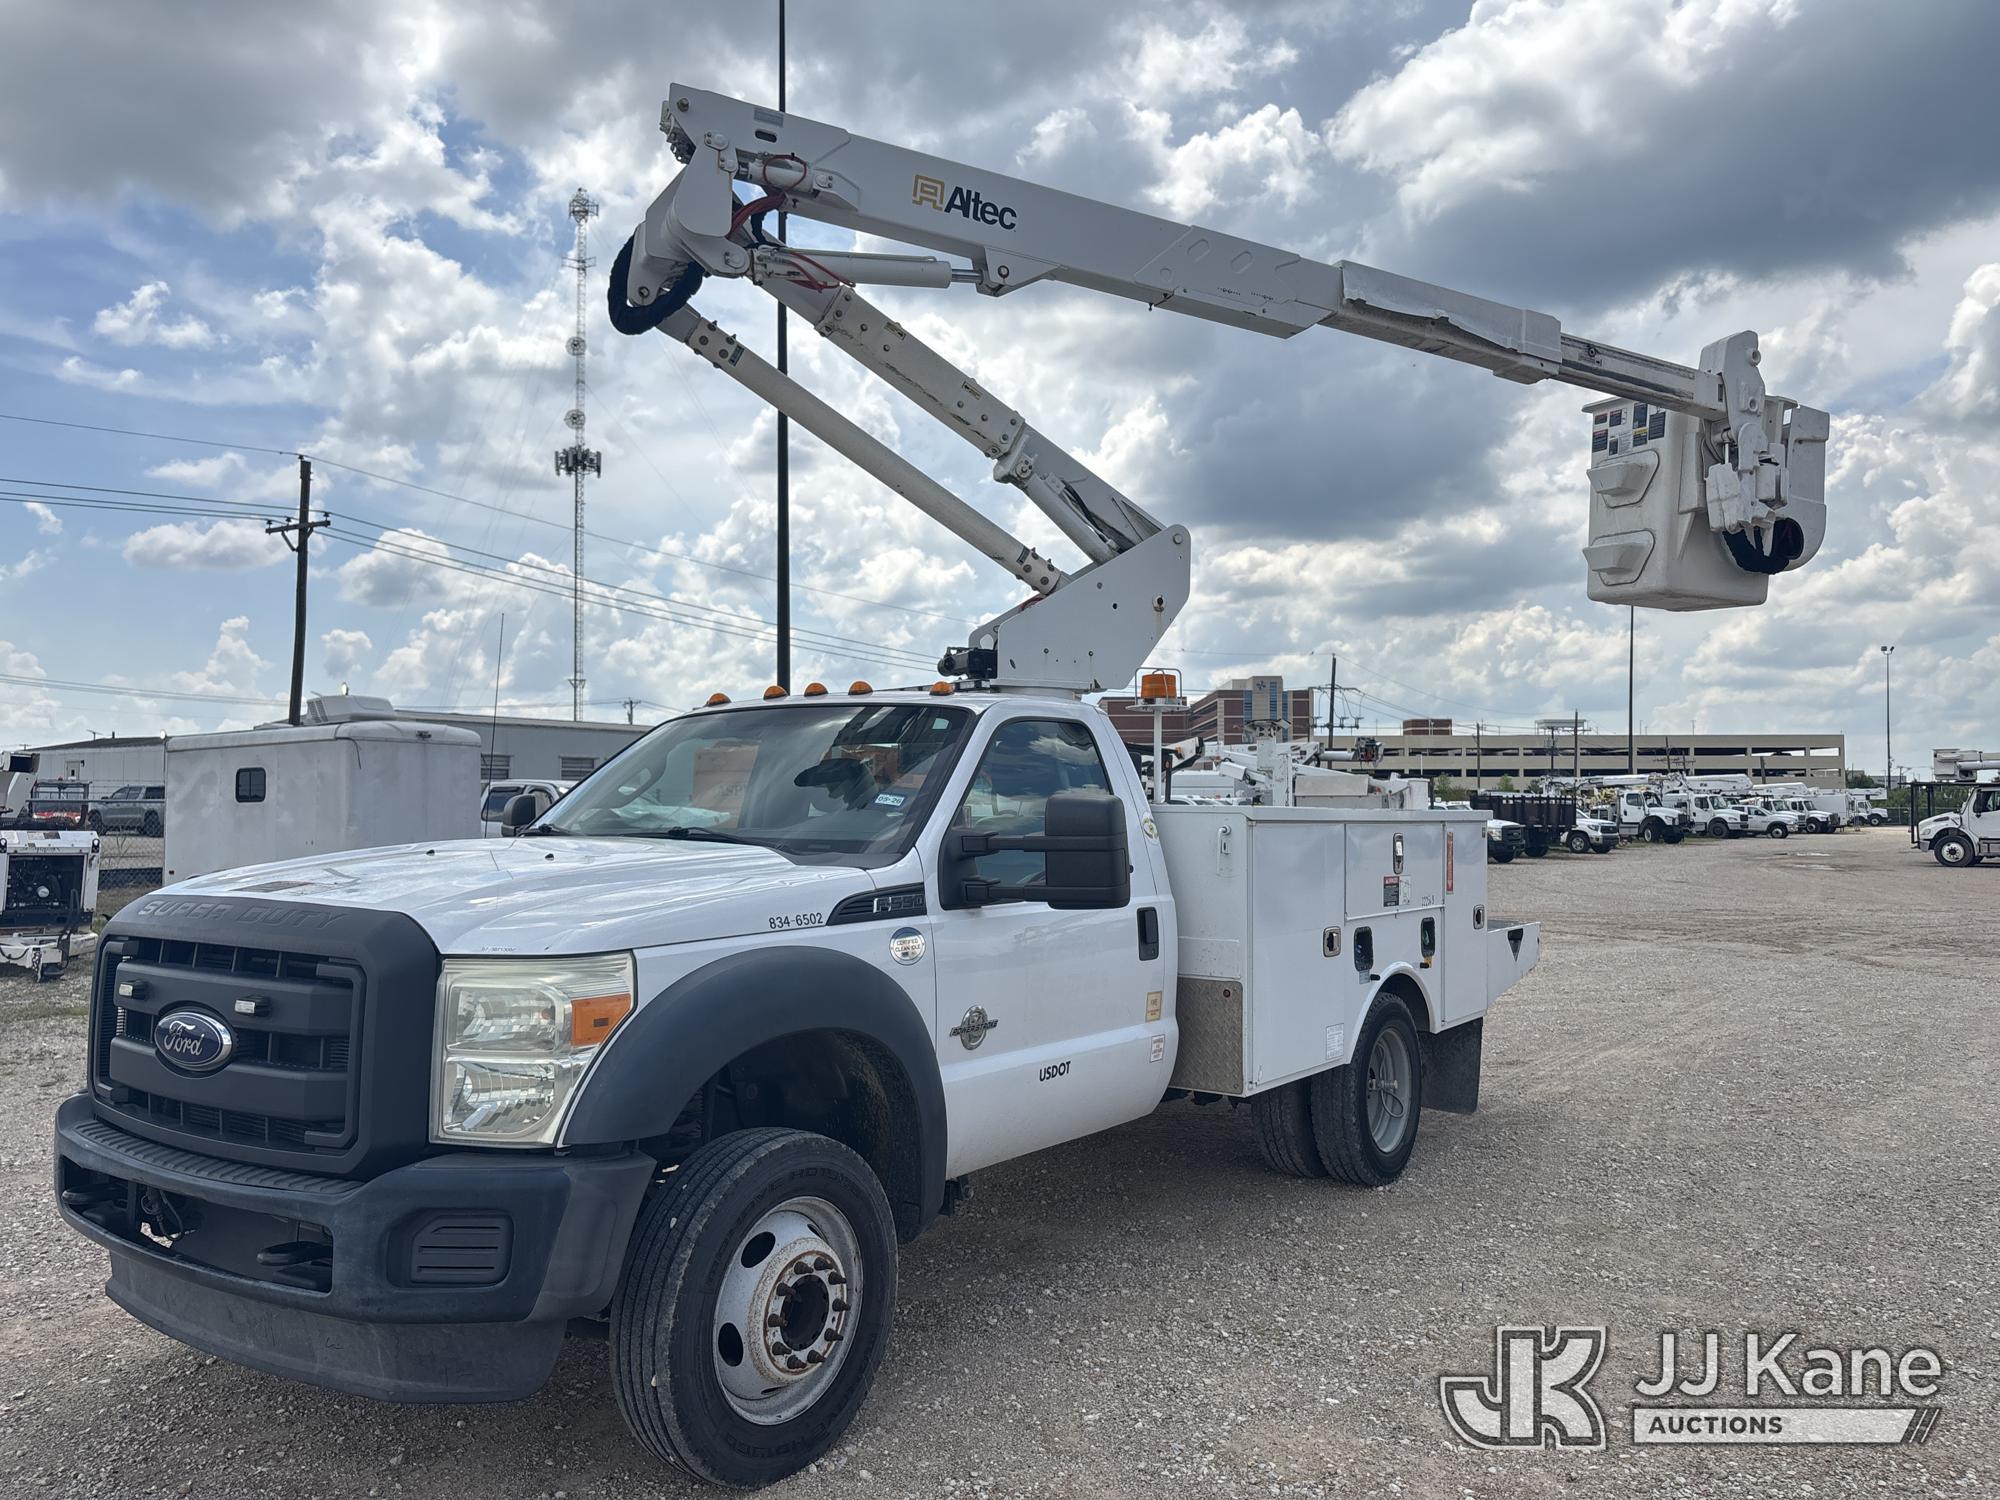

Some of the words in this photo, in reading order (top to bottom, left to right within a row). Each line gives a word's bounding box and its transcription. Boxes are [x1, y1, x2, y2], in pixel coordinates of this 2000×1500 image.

[944, 186, 1017, 231] Altec
[137, 900, 233, 921] SUPER
[236, 906, 347, 929] DUTY
[768, 912, 823, 929] 834-6502
[163, 1020, 206, 1056] Ford
[1039, 1061, 1071, 1082] USDOT
